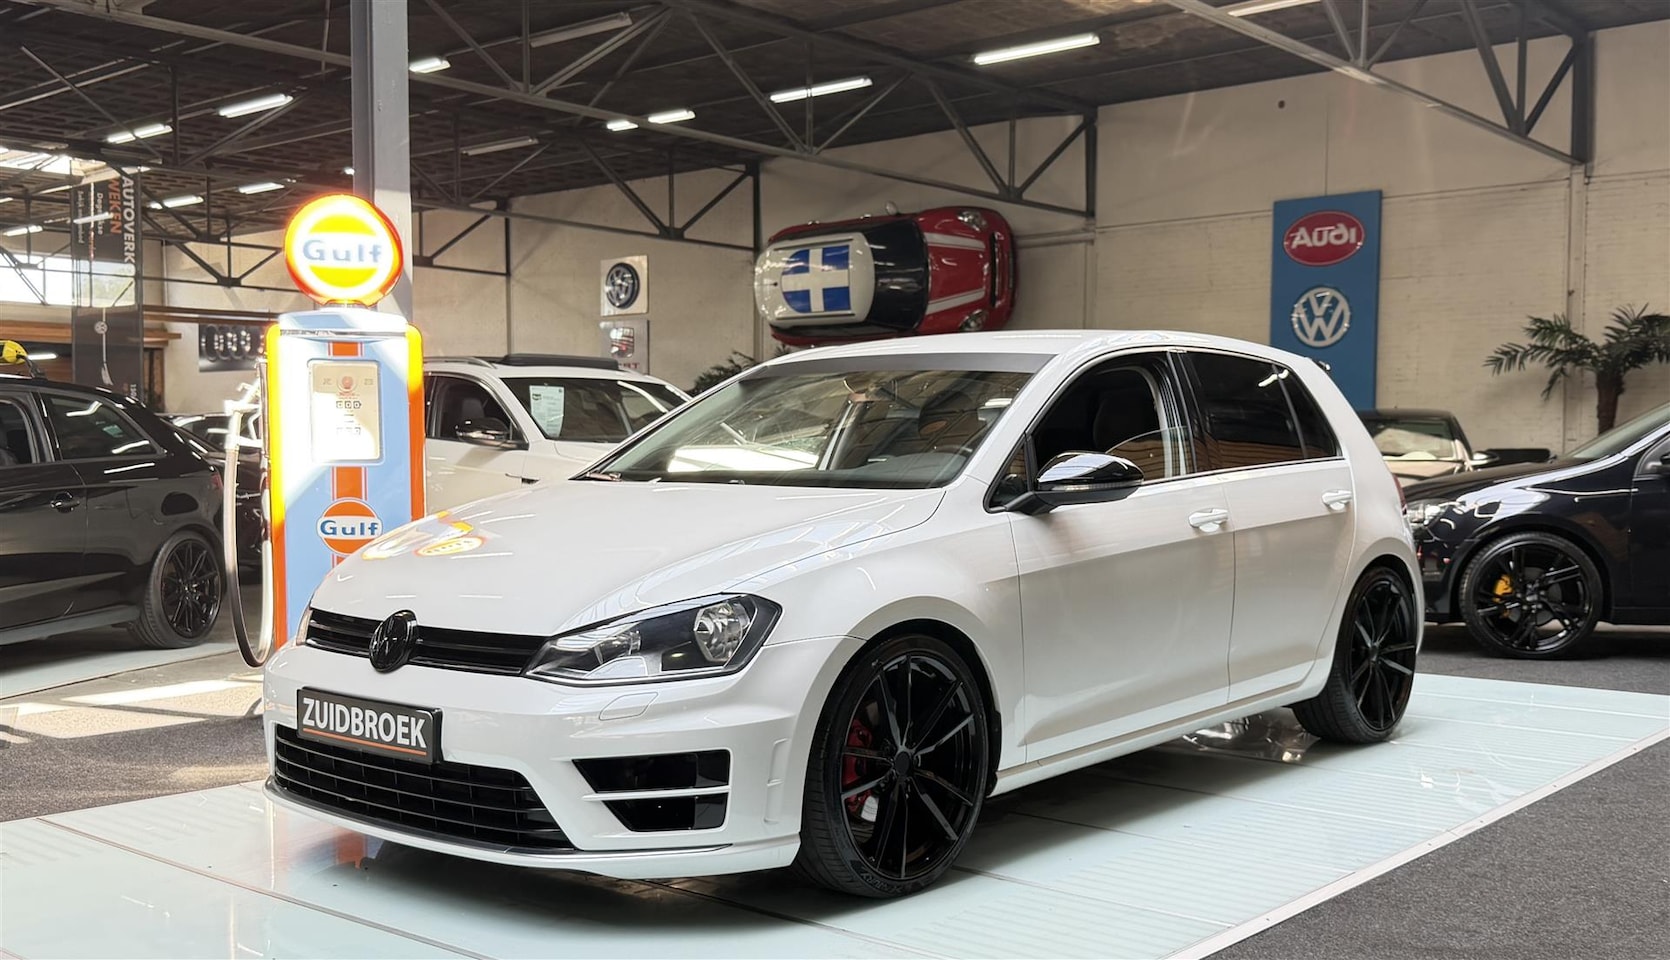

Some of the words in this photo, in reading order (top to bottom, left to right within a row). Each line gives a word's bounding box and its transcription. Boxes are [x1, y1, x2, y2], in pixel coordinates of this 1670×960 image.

[303, 239, 382, 263] Gulf
[320, 520, 378, 536] Gulf
[302, 697, 427, 749] ZUIDBROEK
